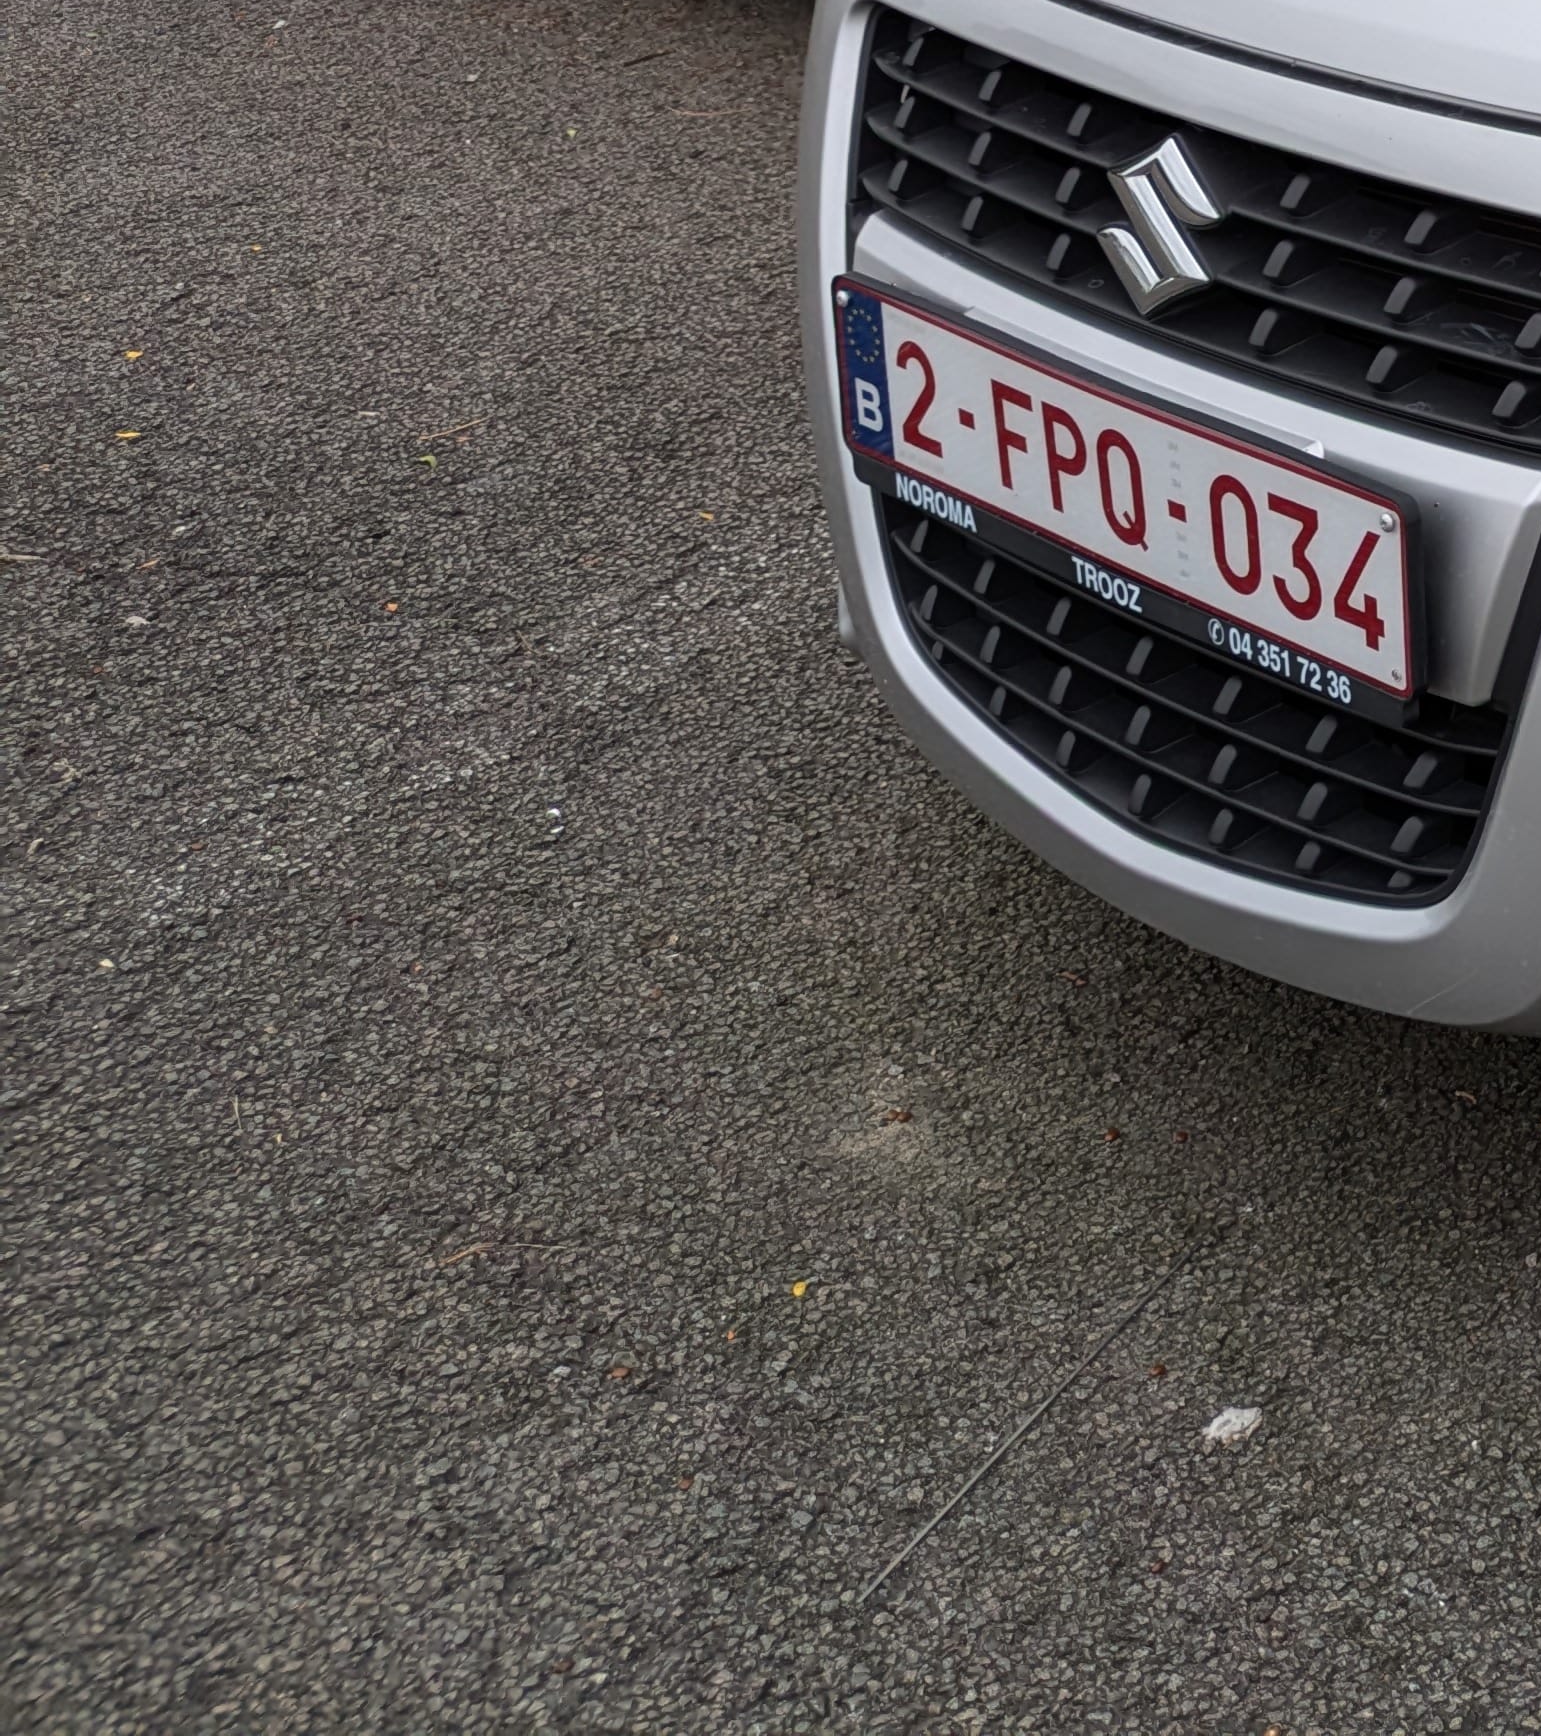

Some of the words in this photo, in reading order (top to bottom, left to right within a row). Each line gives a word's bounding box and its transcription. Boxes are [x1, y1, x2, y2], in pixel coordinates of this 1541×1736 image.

[854, 376, 884, 433] B
[895, 471, 978, 533] NOROMA
[896, 340, 1386, 652] 2-FPQ-034
[1071, 555, 1143, 613] TROOZ
[1229, 627, 1253, 660] 04
[1257, 639, 1291, 678] 351
[1297, 656, 1323, 692] 72
[1327, 670, 1352, 704] 36
